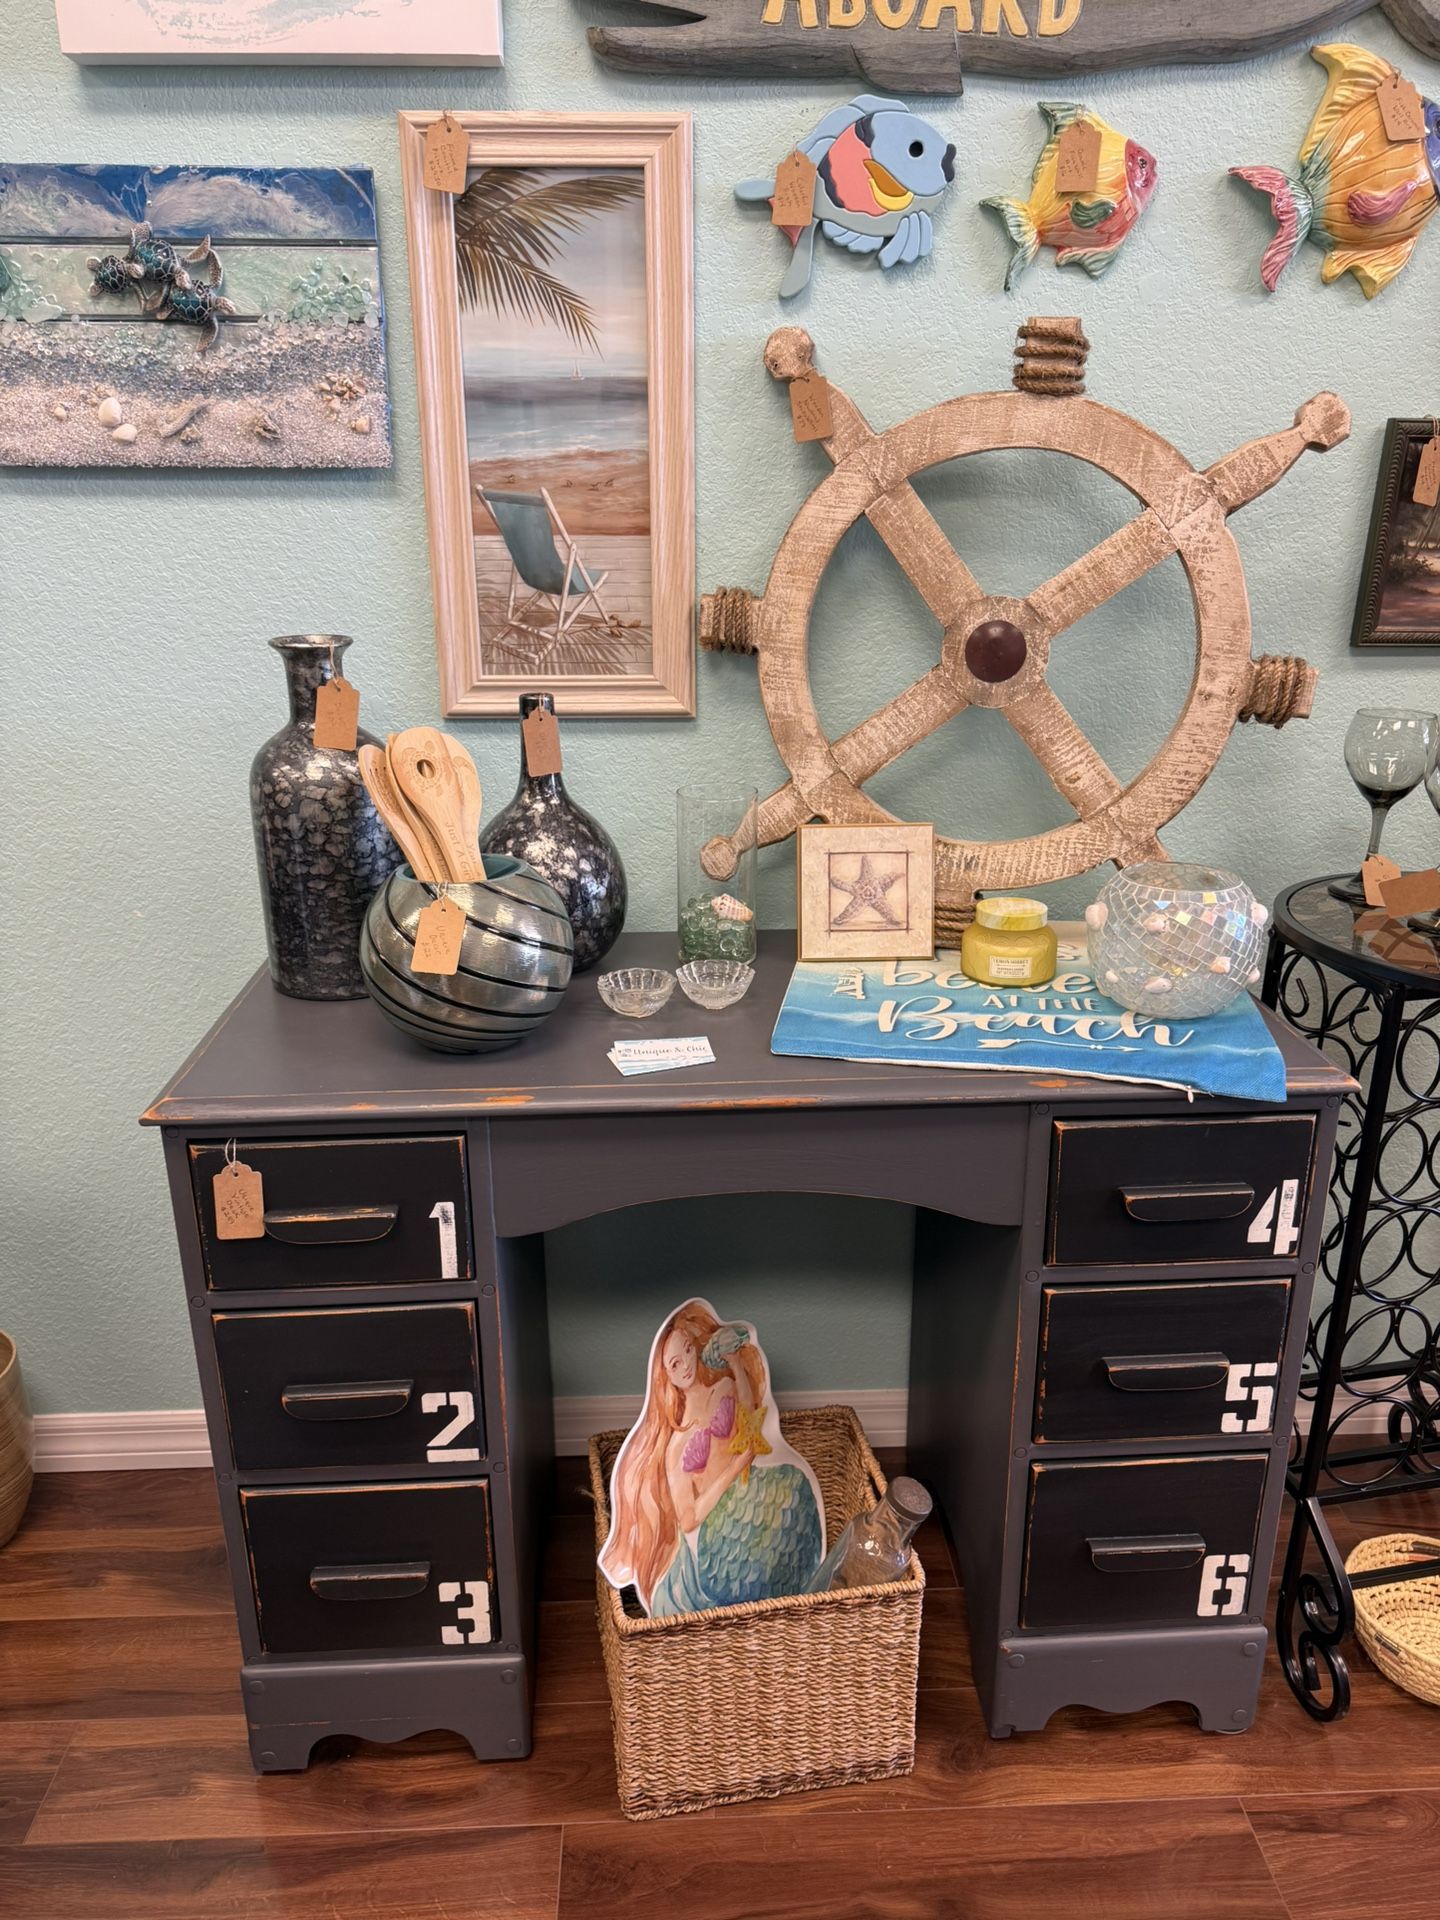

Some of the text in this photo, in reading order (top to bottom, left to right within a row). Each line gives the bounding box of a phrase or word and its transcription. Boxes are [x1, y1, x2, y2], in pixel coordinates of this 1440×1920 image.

[878, 995, 1195, 1047] Beach
[982, 994, 1101, 1012] AT THE
[429, 1201, 459, 1279] 1
[1247, 1179, 1299, 1255] 4
[421, 1391, 480, 1463] 2
[1221, 1362, 1278, 1433] 5
[438, 1581, 492, 1645] 3
[1197, 1554, 1250, 1617] 6
